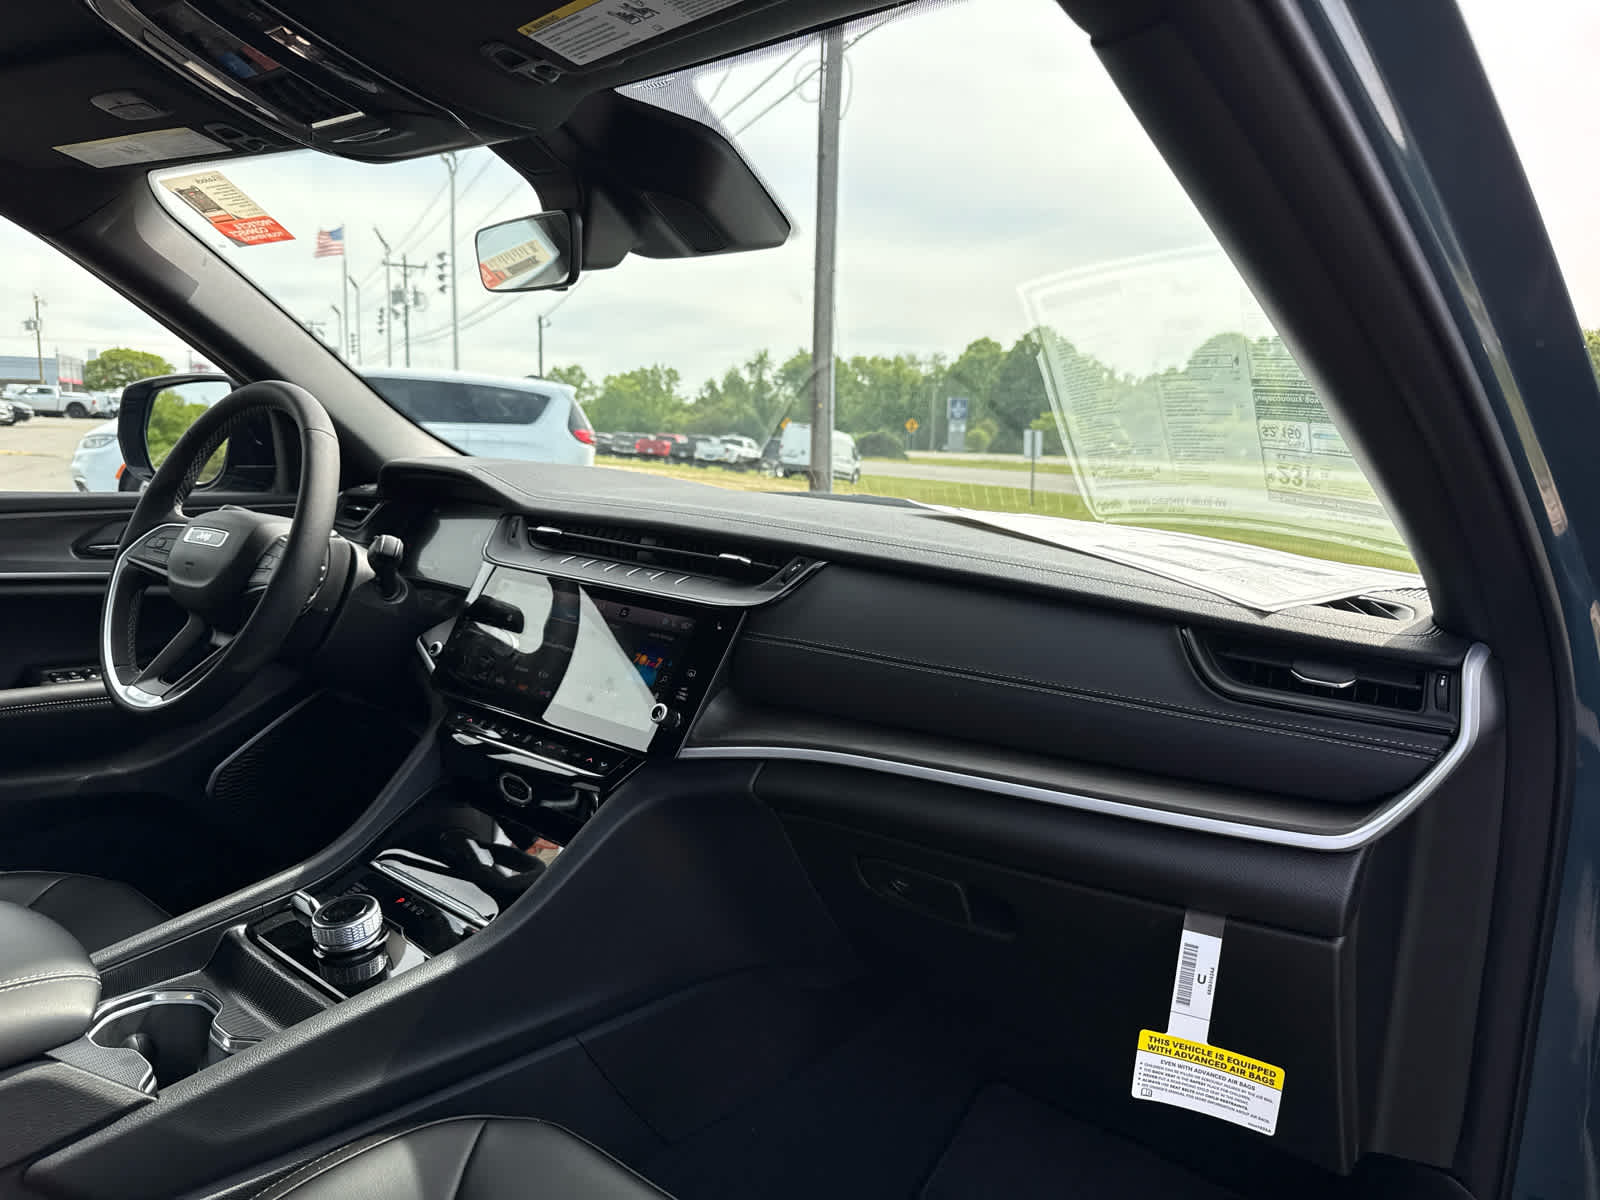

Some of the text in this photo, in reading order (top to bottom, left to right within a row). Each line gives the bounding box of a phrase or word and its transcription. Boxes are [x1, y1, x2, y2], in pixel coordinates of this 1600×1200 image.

[1197, 974, 1206, 984] U
[1147, 1044, 1274, 1085] WITH ADVANCED AIR BAGS
[1148, 1036, 1169, 1046] THIS
[1172, 1042, 1212, 1057] VEHICLE
[1227, 1057, 1276, 1077] EQUIPPED
[1194, 1068, 1226, 1081] ADVANCED
[1239, 1082, 1255, 1091] BAGS
